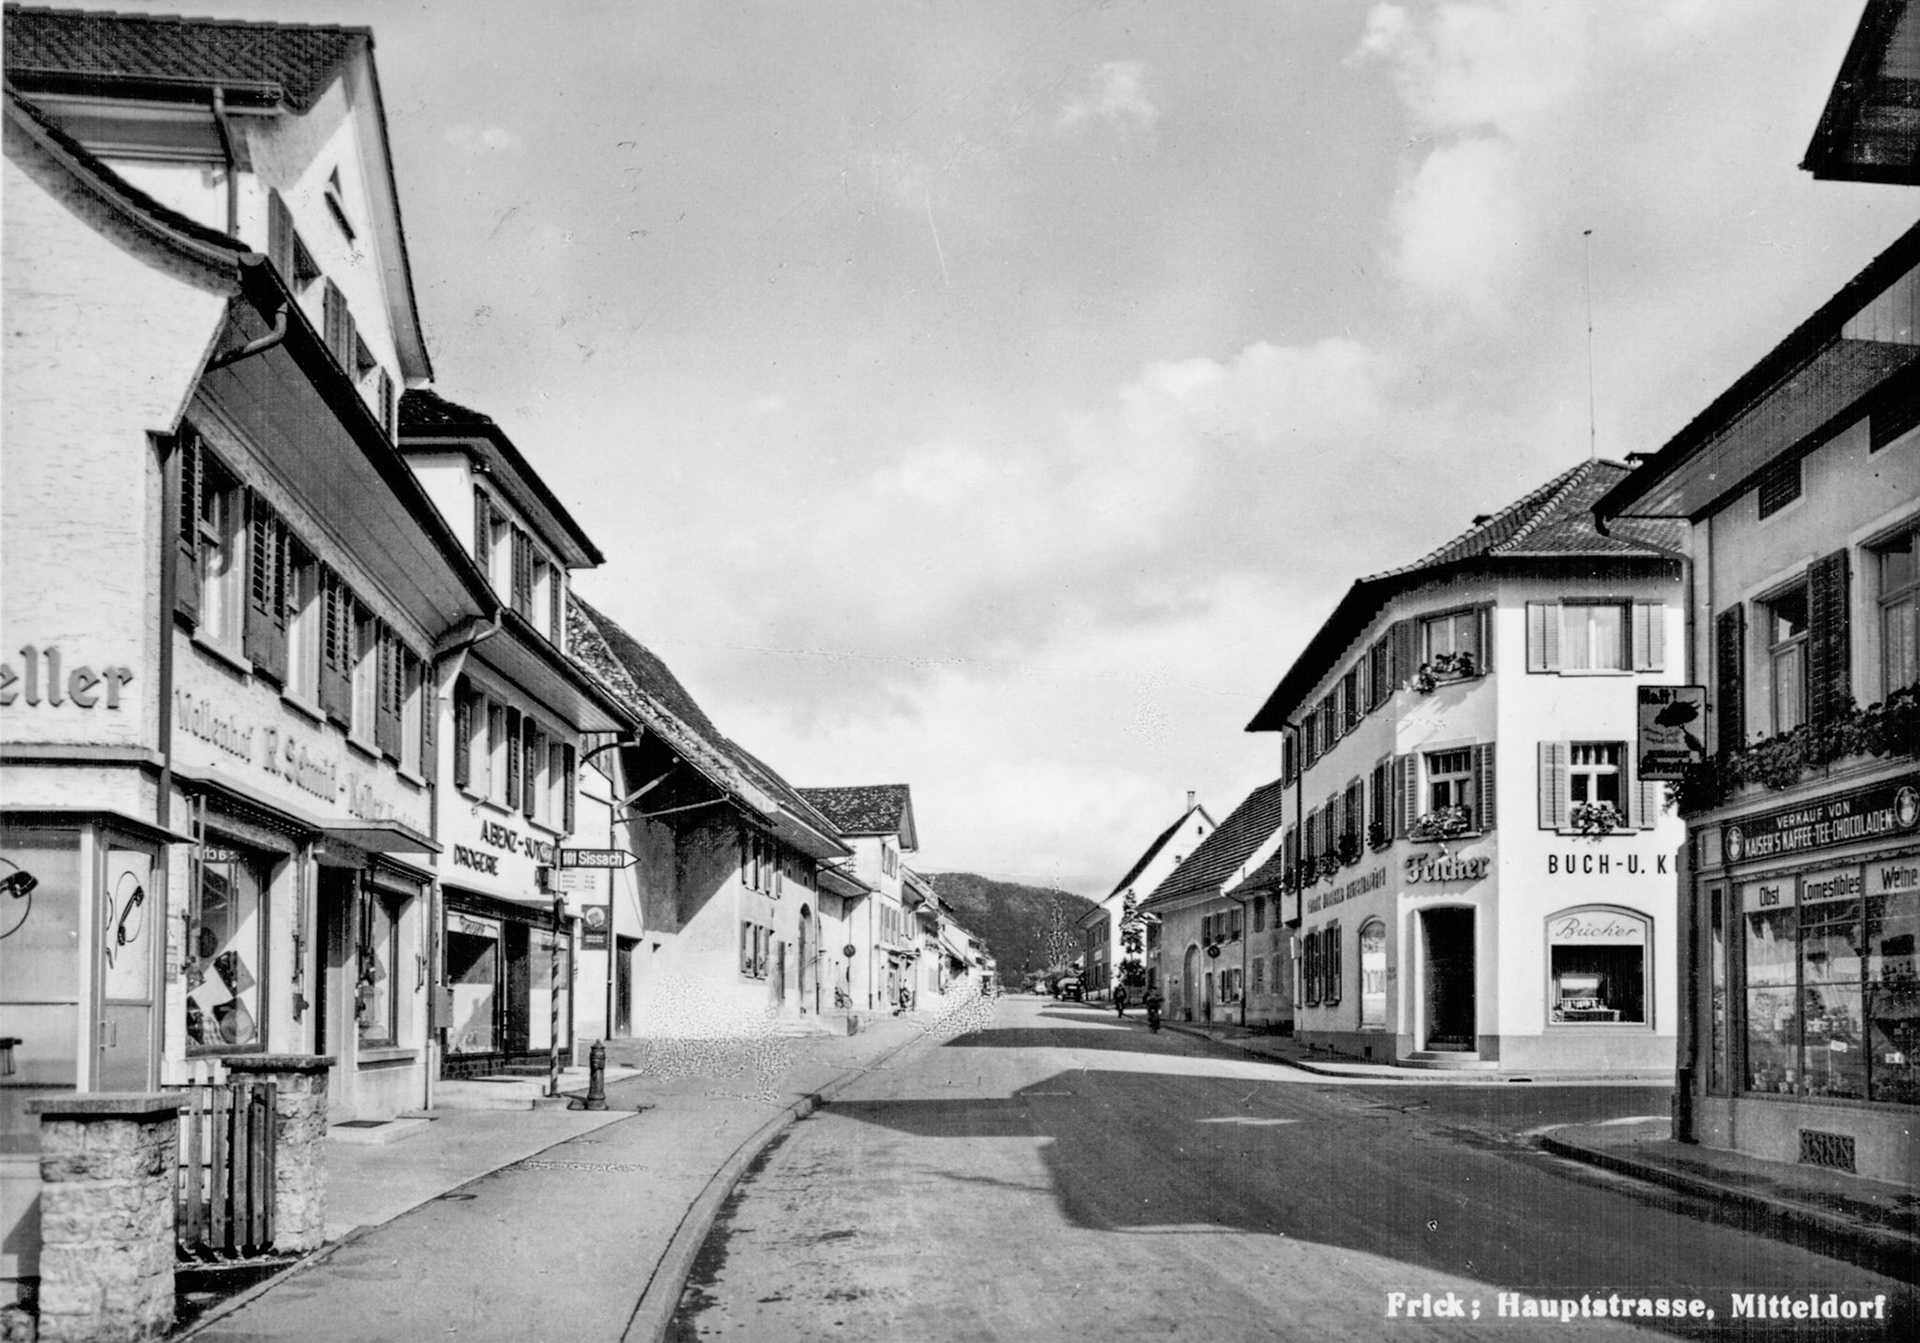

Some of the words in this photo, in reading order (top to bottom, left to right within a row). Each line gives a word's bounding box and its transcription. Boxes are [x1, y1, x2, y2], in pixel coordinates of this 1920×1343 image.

[1776, 807, 1823, 829] VERKAUF
[1828, 800, 1850, 818] VON
[563, 851, 577, 866] 101
[578, 850, 623, 866] Sissach
[1404, 852, 1491, 884] Fricker
[1657, 854, 1678, 874] K
[1802, 873, 1860, 901] Comestibles
[1881, 866, 1918, 890] Weine
[1759, 885, 1779, 907] Obst
[1555, 917, 1638, 939] Bücher
